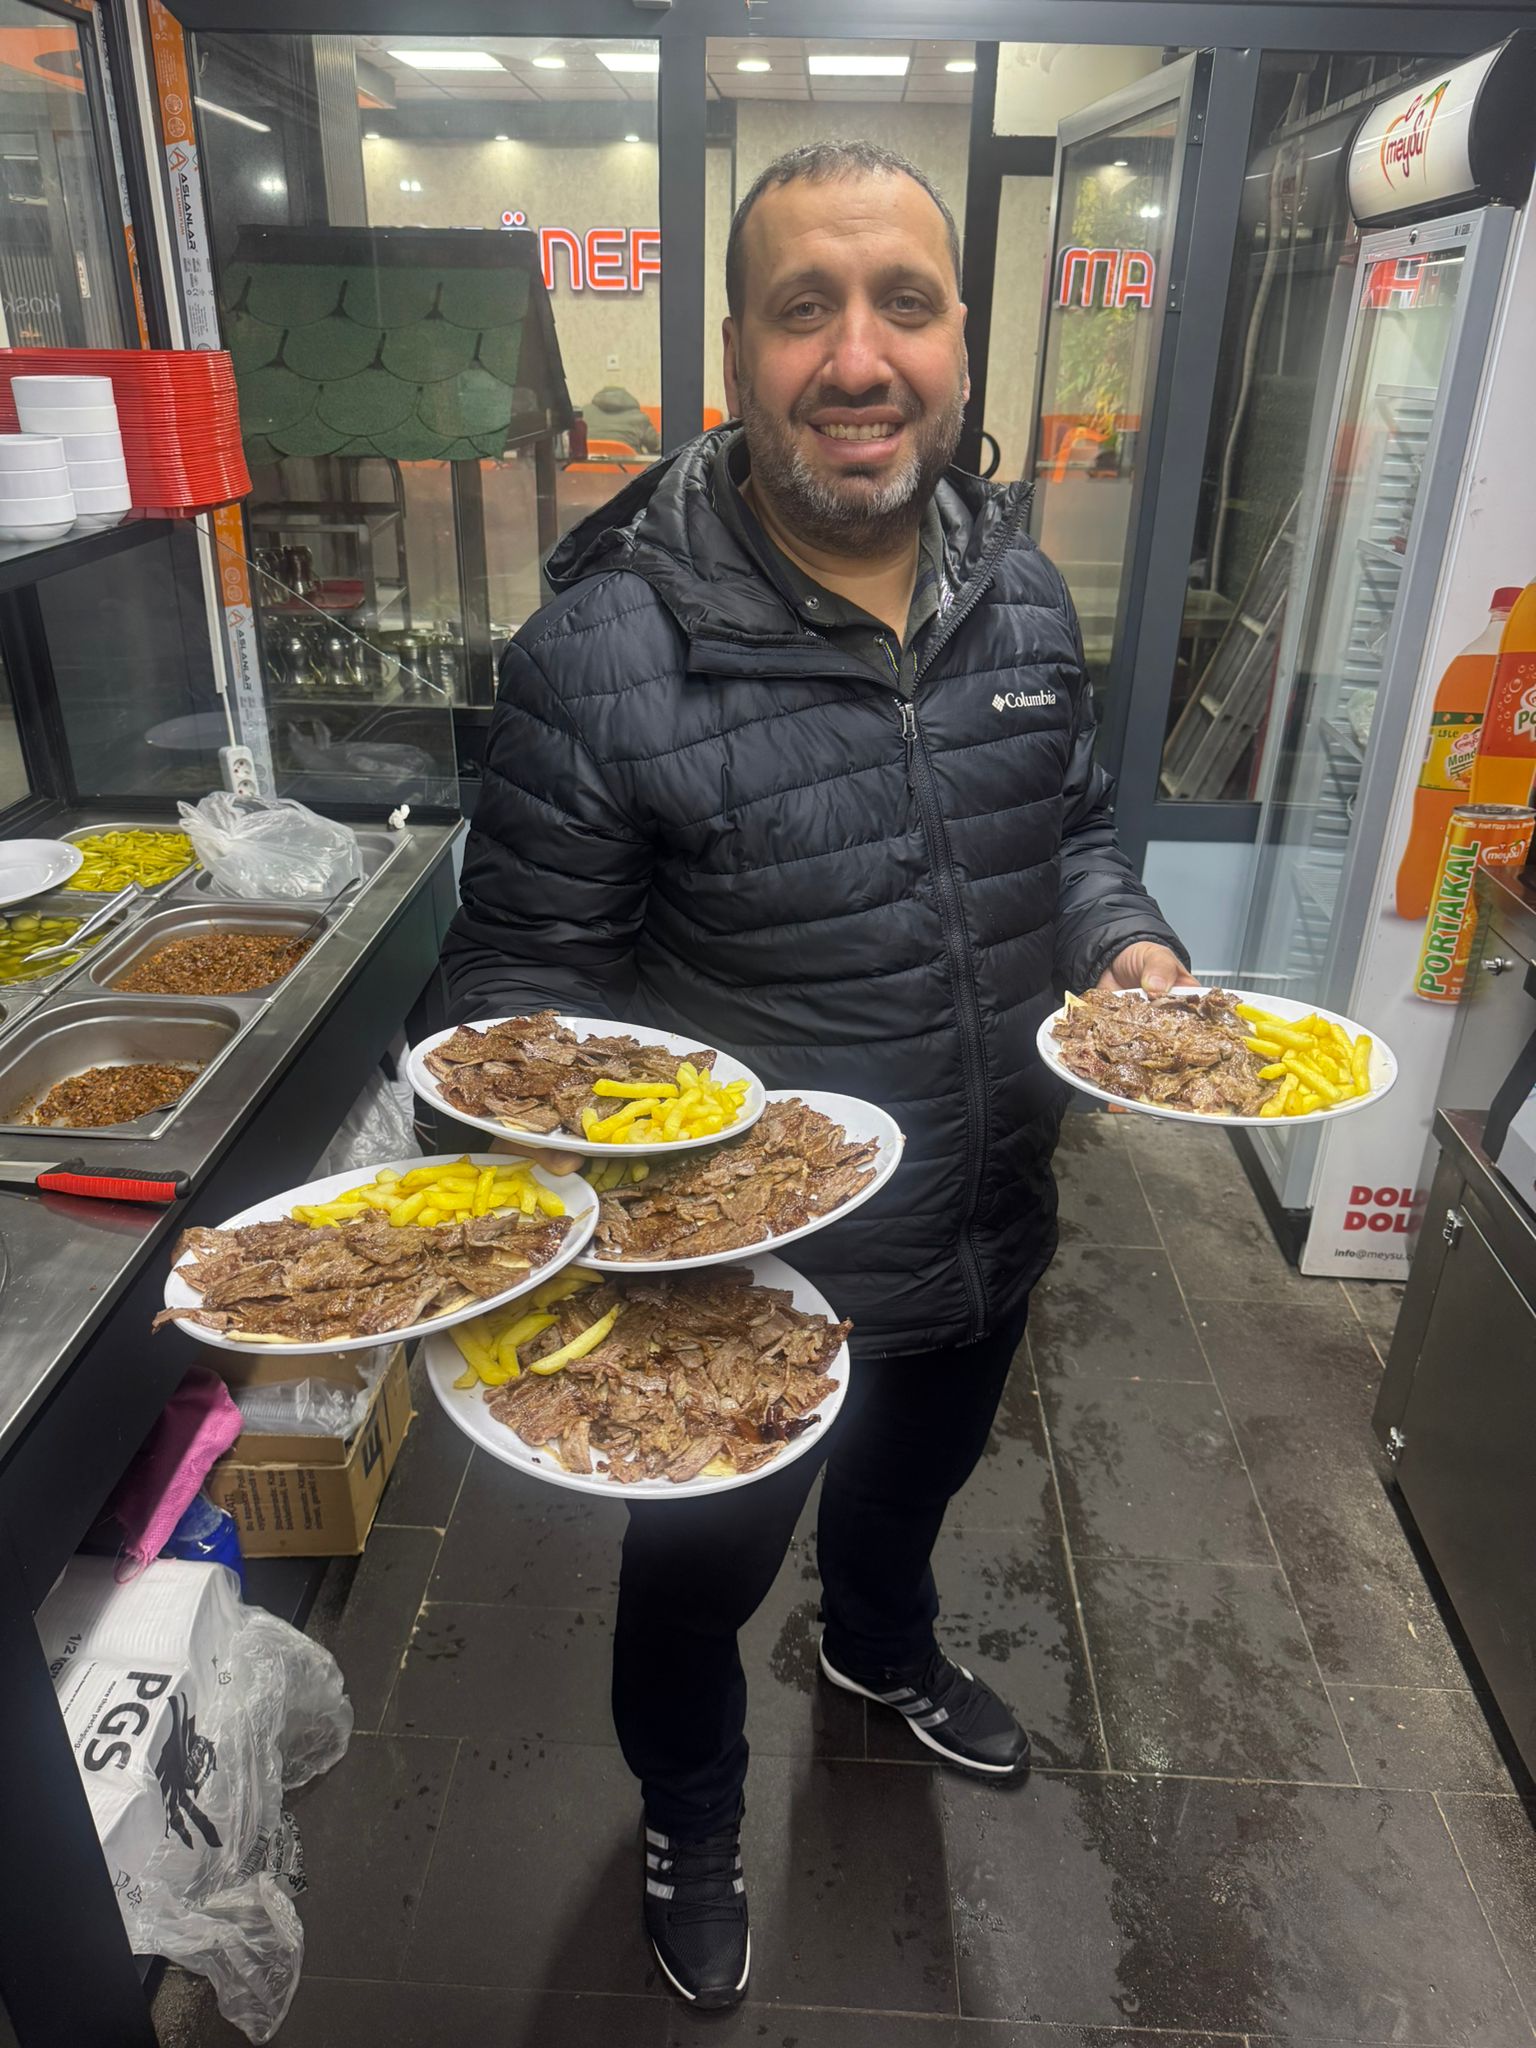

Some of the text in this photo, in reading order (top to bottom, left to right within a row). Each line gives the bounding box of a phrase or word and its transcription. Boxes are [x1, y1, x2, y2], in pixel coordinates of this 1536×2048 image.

[179, 172, 197, 251] ASLANLAR
[1004, 690, 1056, 709] Columbia
[1418, 841, 1481, 995] PORTAKAL
[63, 1633, 82, 1656] 1/2
[83, 1671, 173, 1772] PGS
